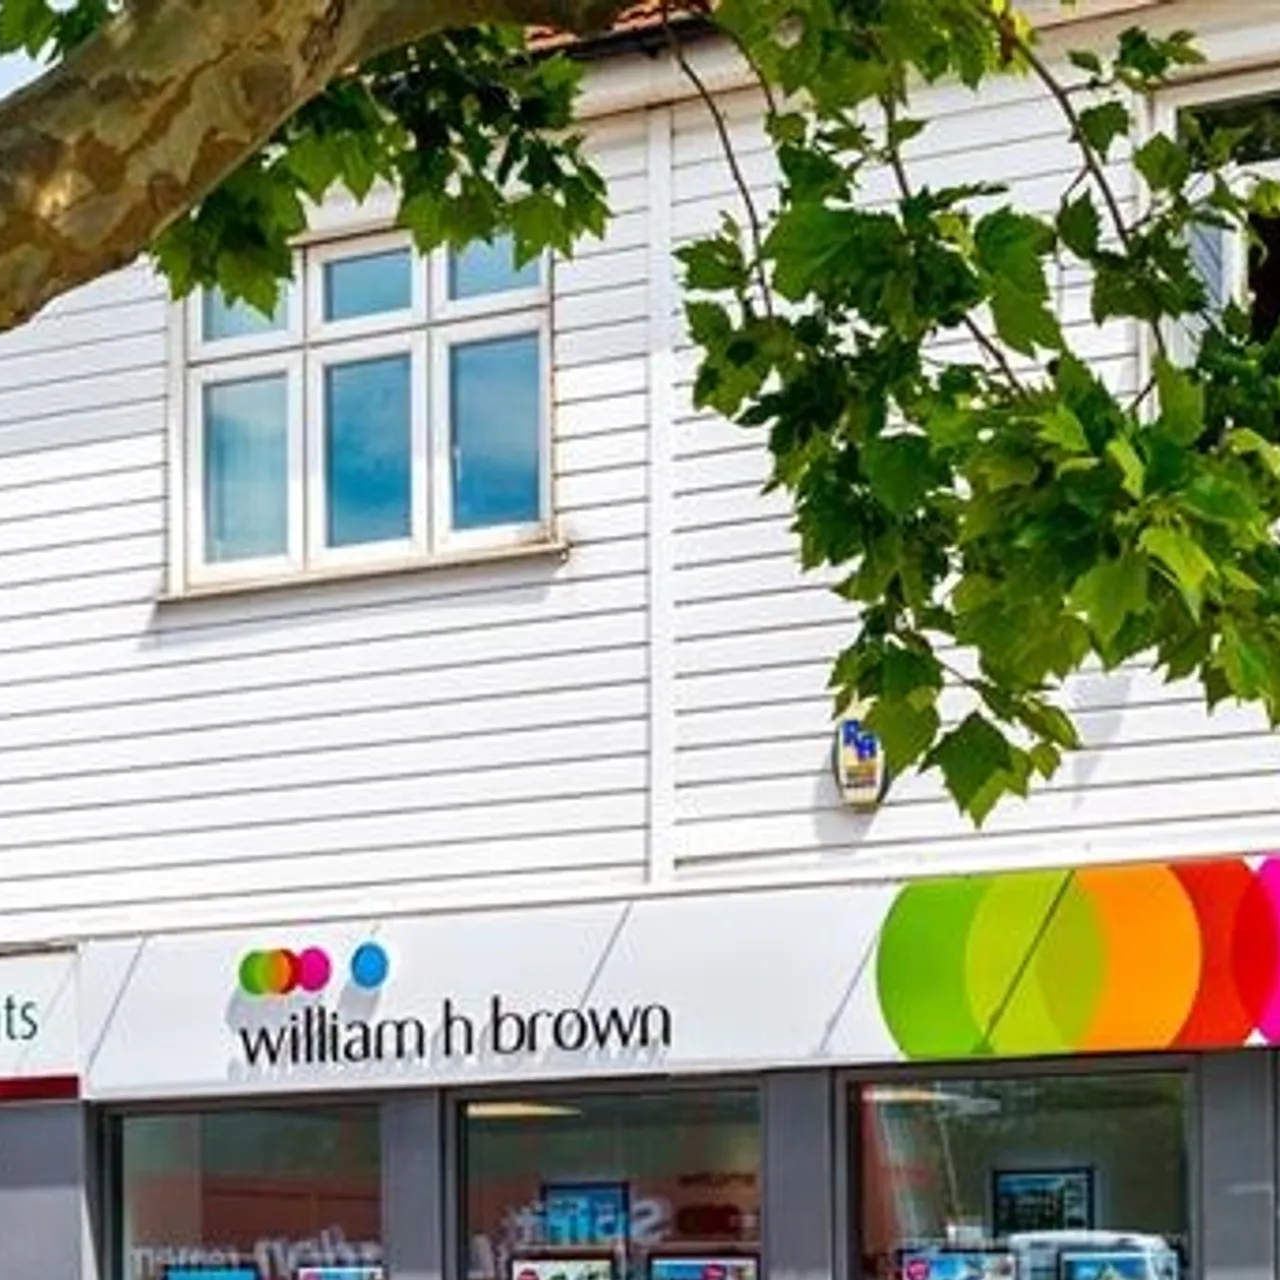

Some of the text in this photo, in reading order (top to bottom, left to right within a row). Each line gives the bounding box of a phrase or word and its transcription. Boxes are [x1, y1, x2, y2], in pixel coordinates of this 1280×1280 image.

[239, 995, 671, 1066] william h brown
